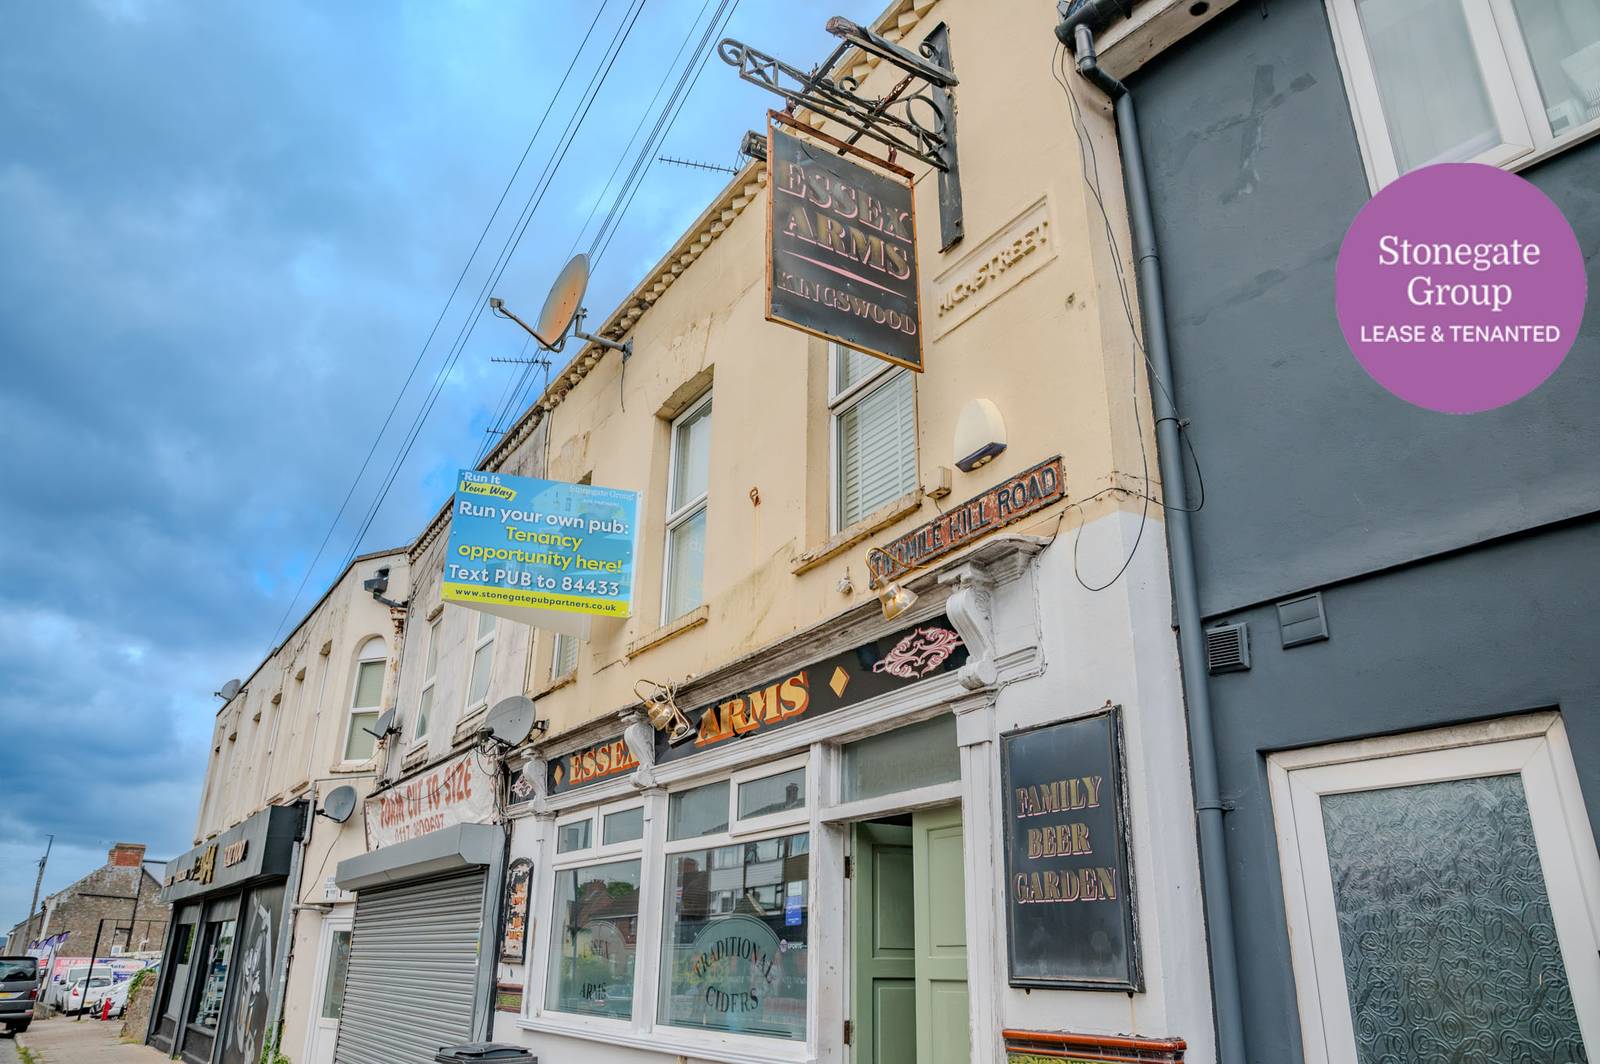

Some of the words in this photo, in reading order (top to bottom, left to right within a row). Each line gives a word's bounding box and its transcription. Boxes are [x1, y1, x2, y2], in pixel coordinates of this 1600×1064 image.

[778, 163, 912, 244] ESSEX
[783, 206, 910, 280] ARMS
[776, 271, 916, 335] KINGSWOOD
[462, 481, 487, 494] Your
[489, 485, 514, 500] Way
[463, 471, 489, 484] Run
[459, 501, 495, 518] Run
[500, 508, 542, 523] your
[546, 514, 584, 529] own
[589, 519, 629, 534] pub:
[905, 523, 944, 562] MILE
[948, 502, 991, 541] HILL
[997, 466, 1057, 519] ROAD
[506, 526, 583, 551] Tenancy
[458, 544, 572, 570] opportunity
[576, 556, 623, 573] here!
[449, 564, 489, 582] Text
[495, 569, 531, 586] PUB
[537, 574, 556, 589] to
[562, 577, 620, 596] 84433
[455, 588, 616, 611] www.stonegatepubpartners.co.uk
[694, 671, 809, 747] ARMS
[427, 774, 440, 812] TO
[444, 757, 472, 808] SIZE
[1015, 775, 1102, 818] FAMILY
[1027, 822, 1092, 859] BEER
[1014, 867, 1117, 904] GARDEN
[694, 936, 776, 984] TRADITIONAL
[705, 985, 759, 1013] CIDERS
